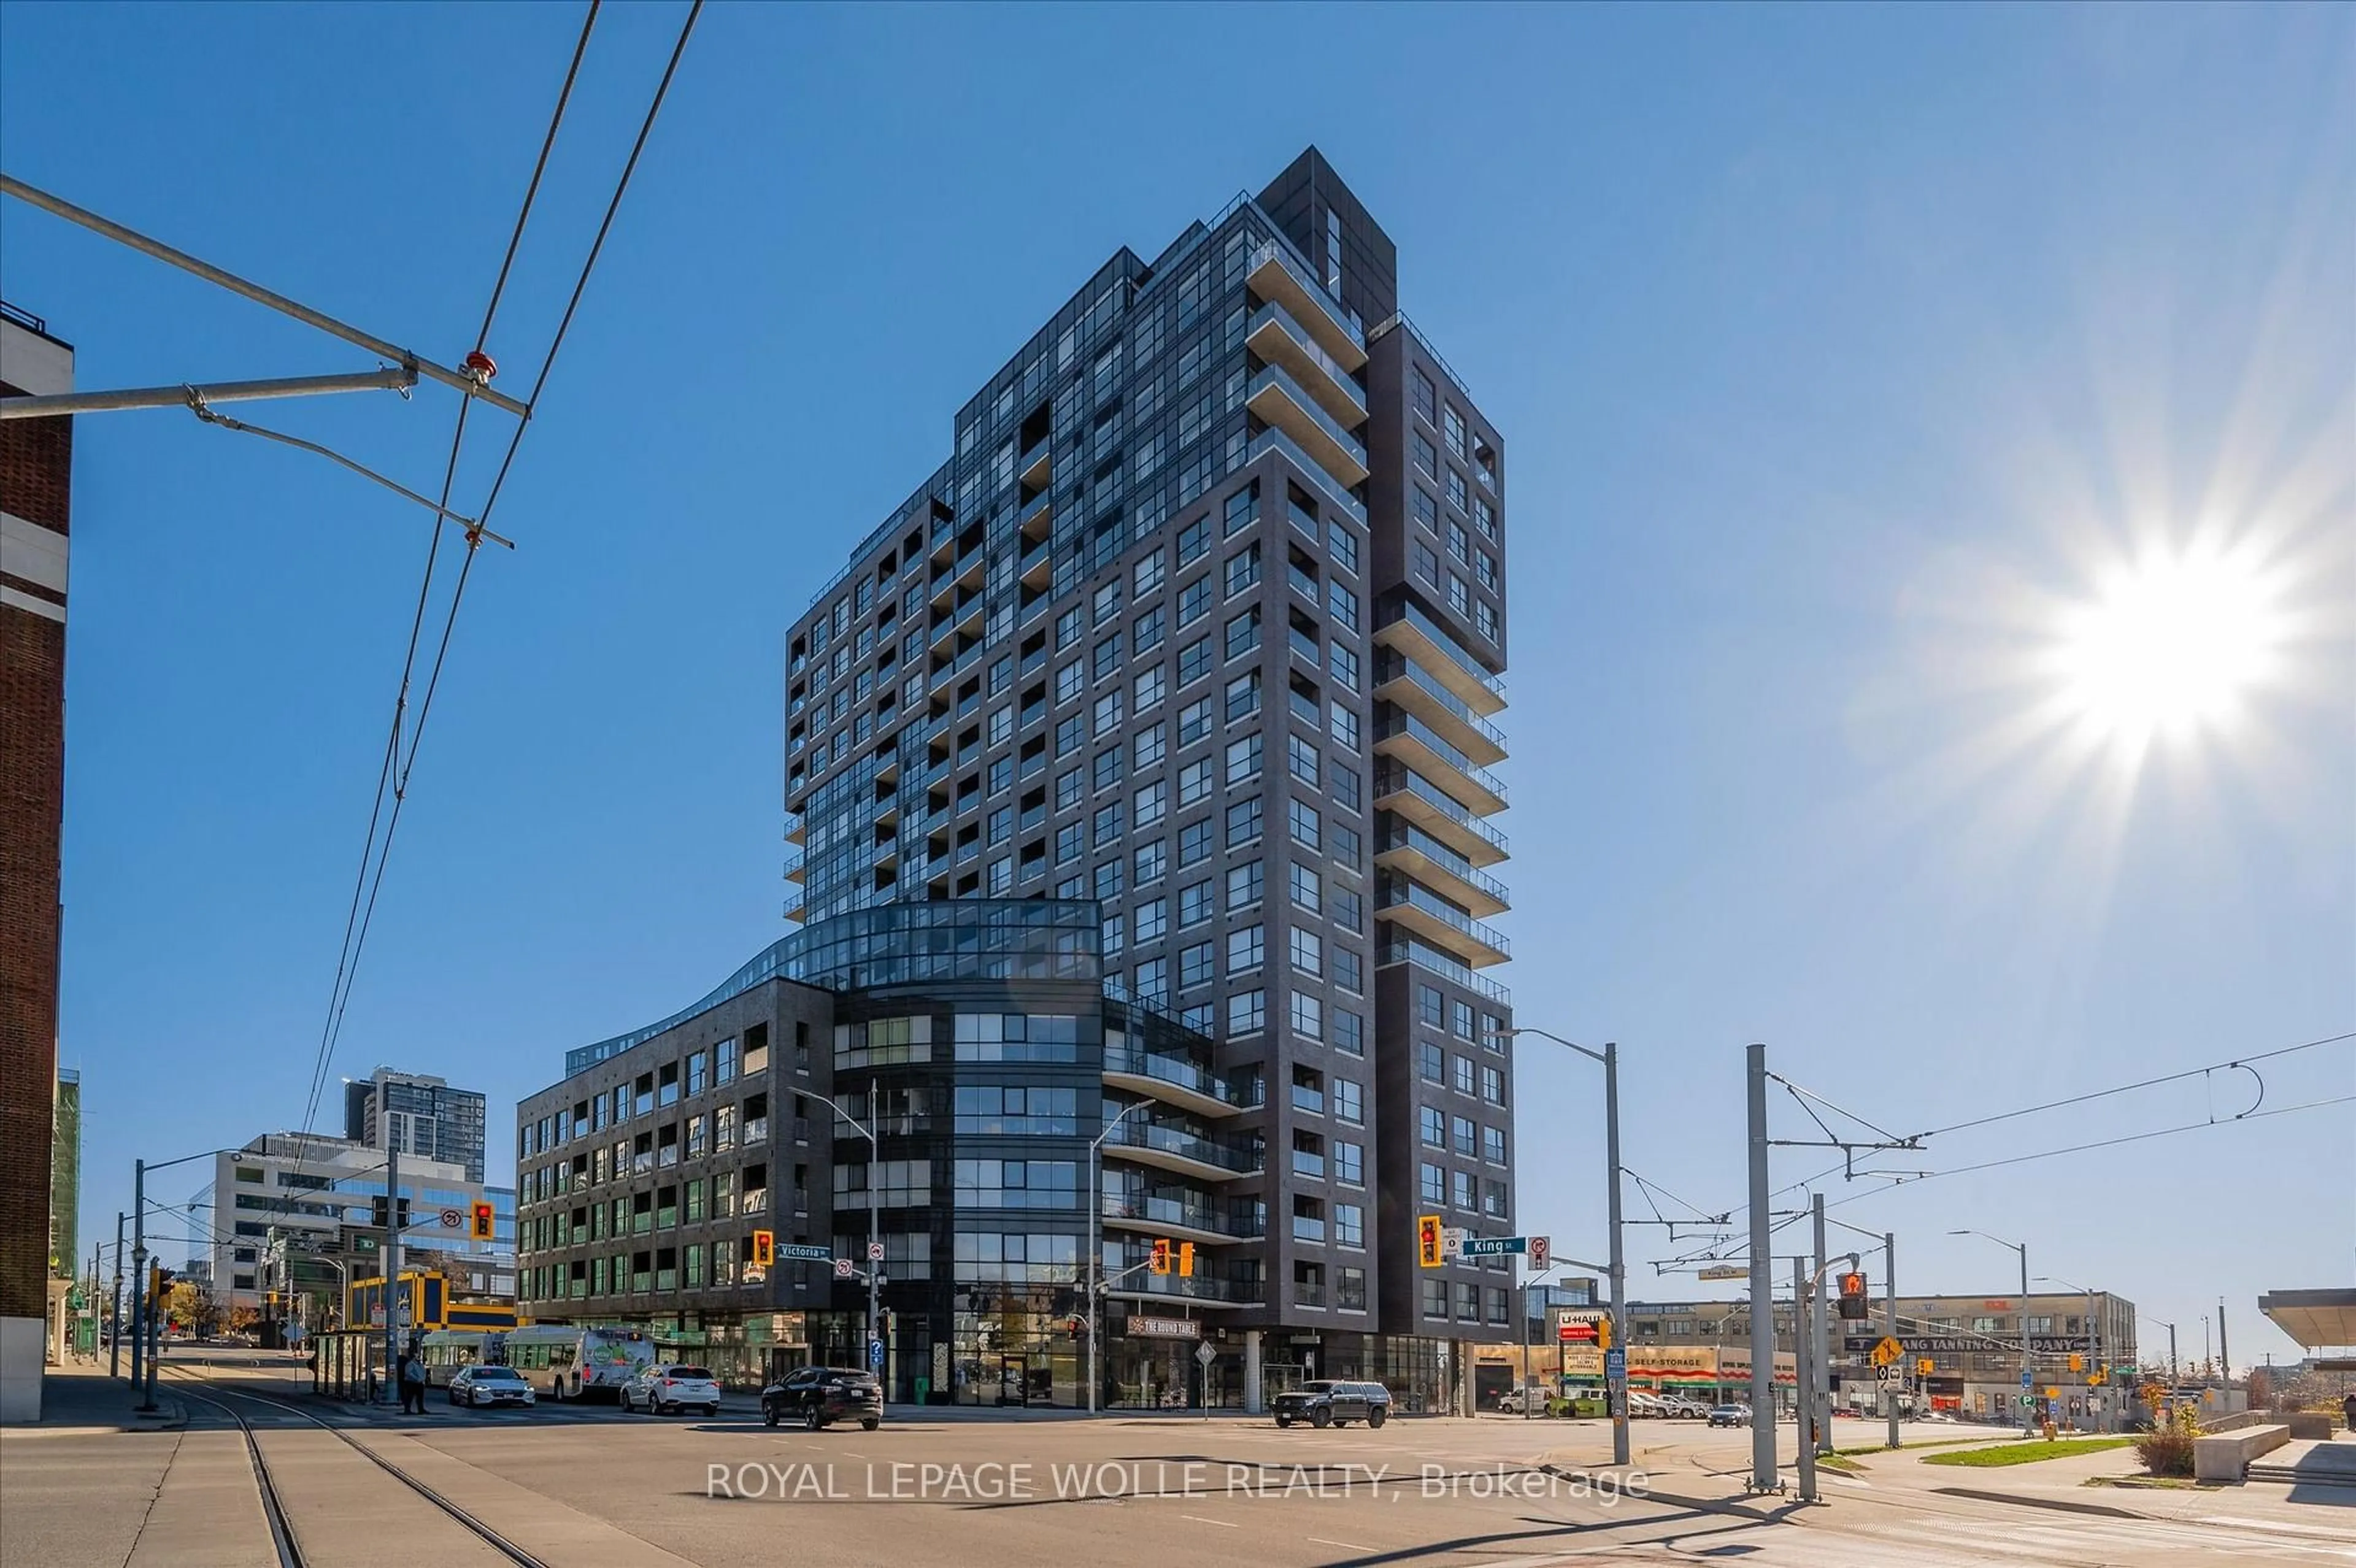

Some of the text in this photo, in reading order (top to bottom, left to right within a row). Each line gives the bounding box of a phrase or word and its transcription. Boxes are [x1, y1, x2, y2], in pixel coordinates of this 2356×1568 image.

[782, 1246, 819, 1257] Victoria
[1474, 1240, 1503, 1255] King
[1145, 1321, 1157, 1332] THE
[1178, 1323, 1196, 1335] TABLE
[1901, 1339, 1927, 1350] ANG
[1933, 1339, 1993, 1350] TANNING
[1634, 1358, 1701, 1367] SELF-STORAGE
[2023, 1396, 2032, 1405] P
